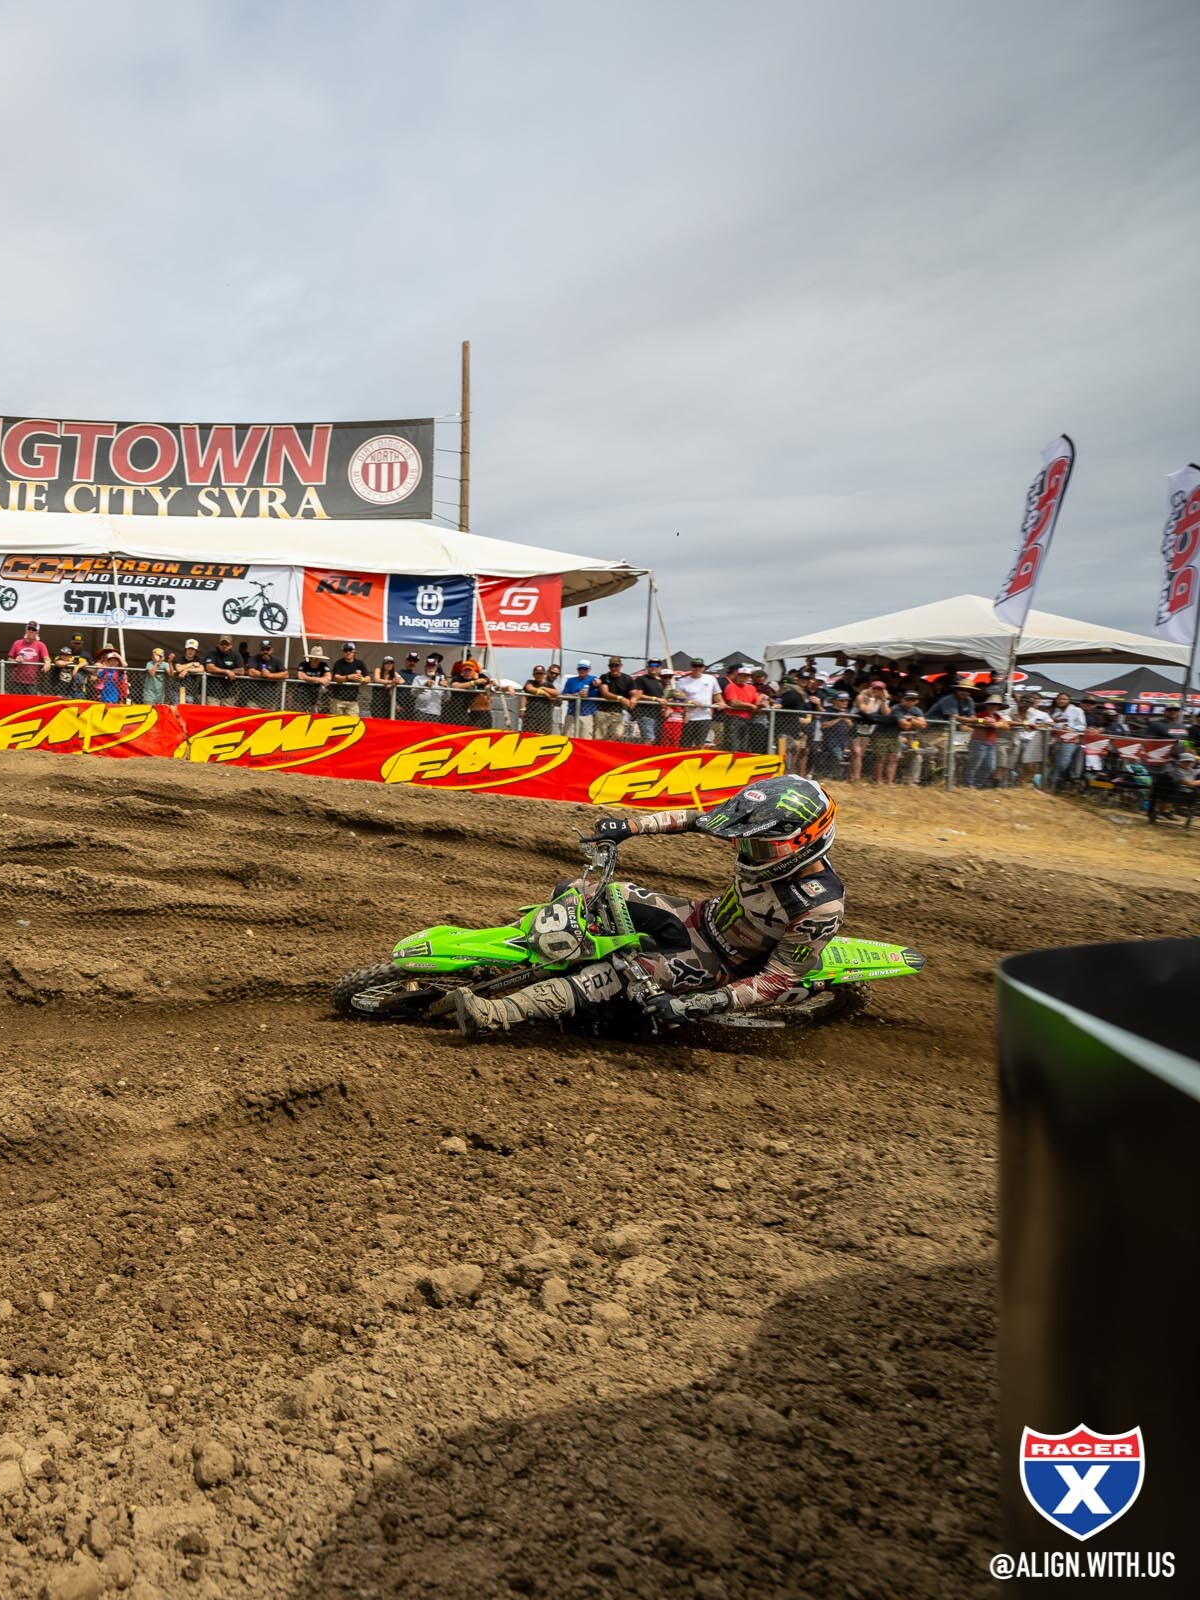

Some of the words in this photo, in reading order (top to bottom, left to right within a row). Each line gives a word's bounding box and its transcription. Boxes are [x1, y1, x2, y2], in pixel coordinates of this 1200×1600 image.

[370, 450, 400, 462] NORTH
[64, 483, 182, 517] CITY
[197, 486, 332, 520] SVRA
[0, 554, 97, 584] CCM
[92, 559, 181, 576] CARSON
[190, 564, 247, 578] CITY
[315, 575, 375, 597] KTM
[63, 589, 176, 618] STACYC
[399, 615, 462, 628] Husqvarna
[487, 621, 552, 633] GASGAS
[189, 714, 361, 764] FMF
[384, 733, 570, 785] FMF
[592, 753, 782, 804] FMF
[746, 791, 763, 800] BELL
[535, 903, 581, 961] 30
[567, 906, 576, 929] LUCAS
[575, 929, 584, 942] OIL
[582, 968, 614, 995] FOX
